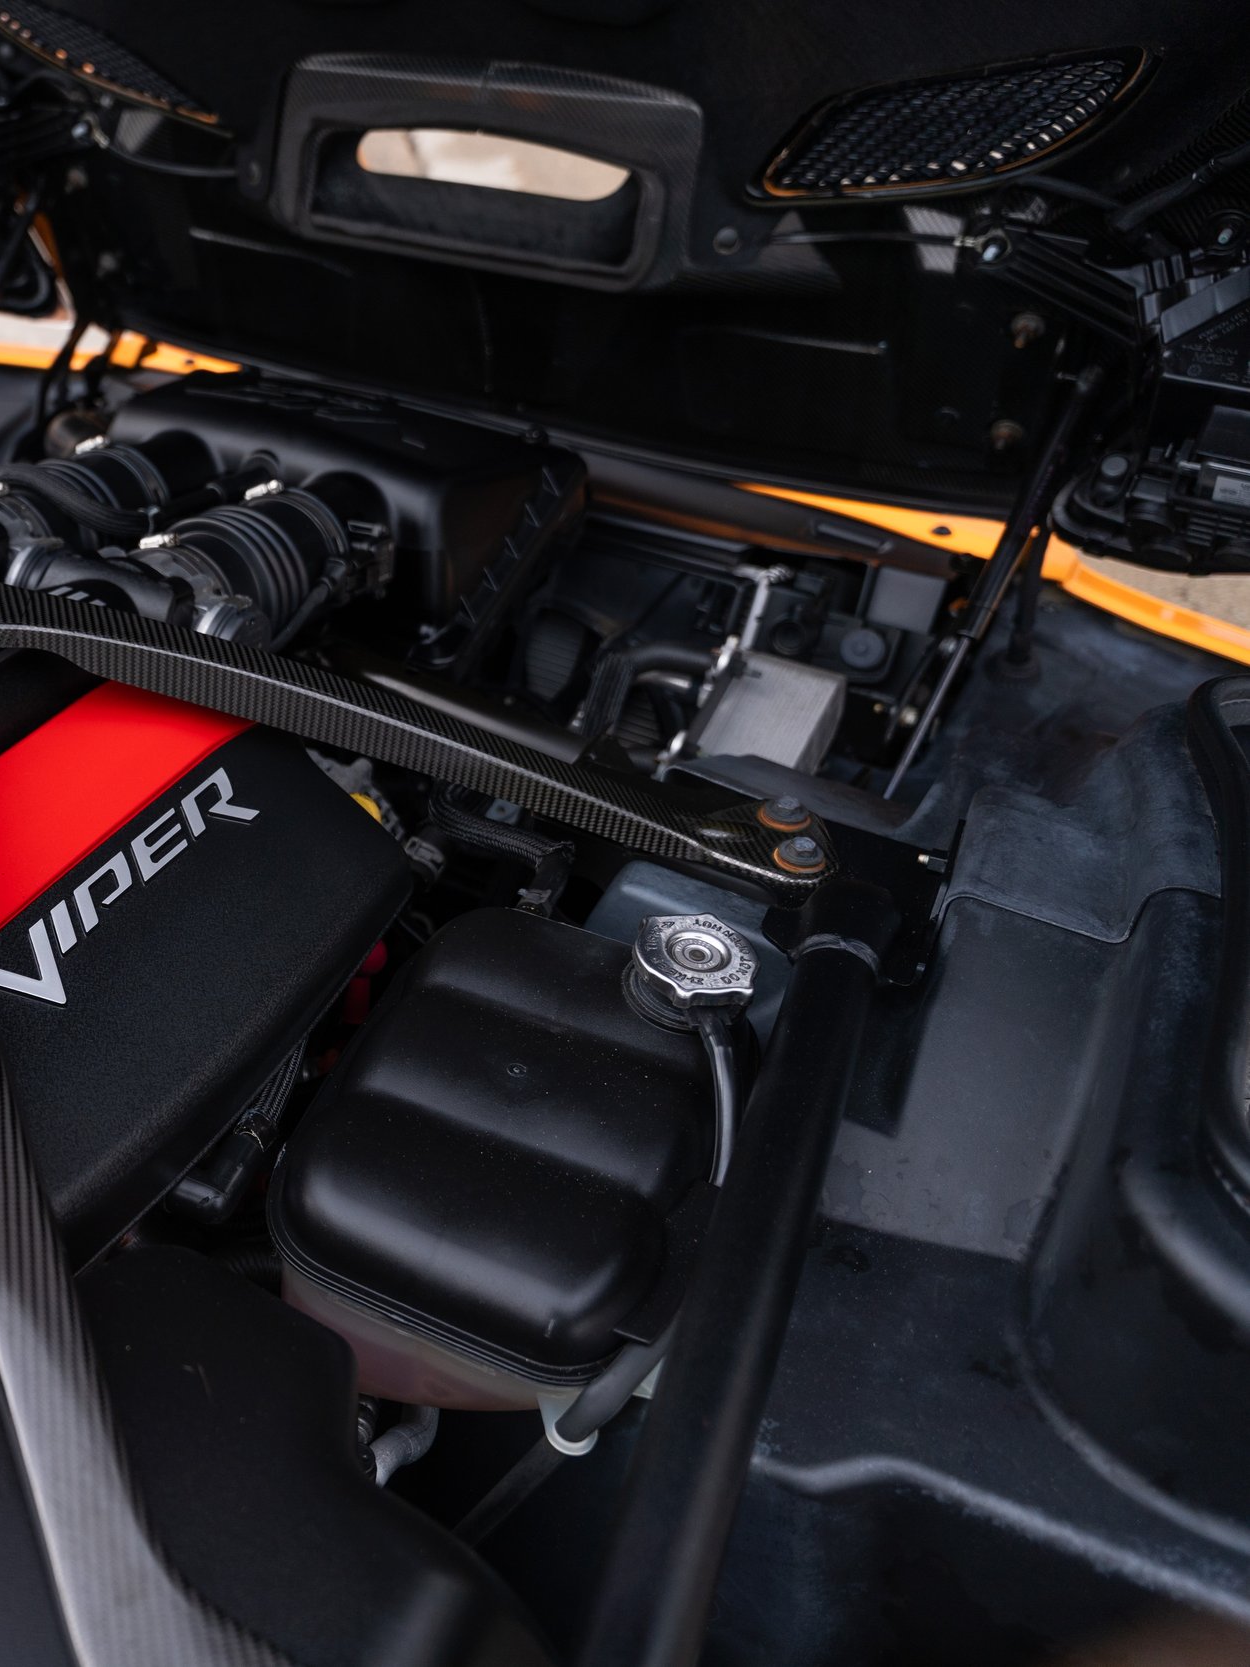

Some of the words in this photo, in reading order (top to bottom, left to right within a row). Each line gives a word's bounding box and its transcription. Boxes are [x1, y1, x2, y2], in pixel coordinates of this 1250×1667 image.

[692, 918, 723, 932] HOT
[723, 930, 751, 955] OPEN
[737, 956, 752, 976] NOT
[720, 973, 741, 985] DO
